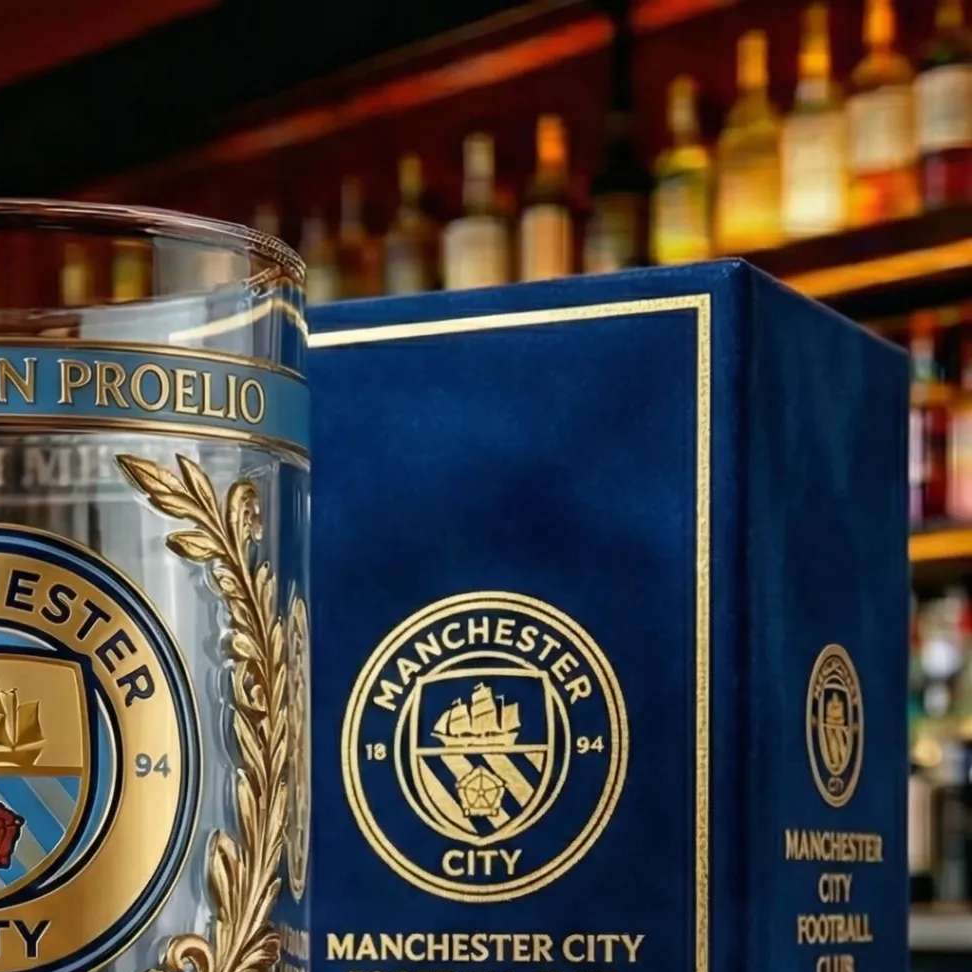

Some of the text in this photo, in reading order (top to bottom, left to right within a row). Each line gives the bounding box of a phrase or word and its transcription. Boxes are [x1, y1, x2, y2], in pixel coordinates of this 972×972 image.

[56, 357, 266, 425] PROELIO
[373, 616, 593, 712] MANCHESTER
[365, 743, 388, 761] 18
[576, 736, 605, 754] 94
[134, 753, 172, 779] 94
[785, 829, 883, 863] MANCHESTER
[441, 848, 523, 876] CITY
[818, 873, 853, 904] CITY
[797, 914, 873, 945] FOOTBALL
[326, 932, 553, 962] MANCHESTER
[561, 934, 647, 963] CITY
